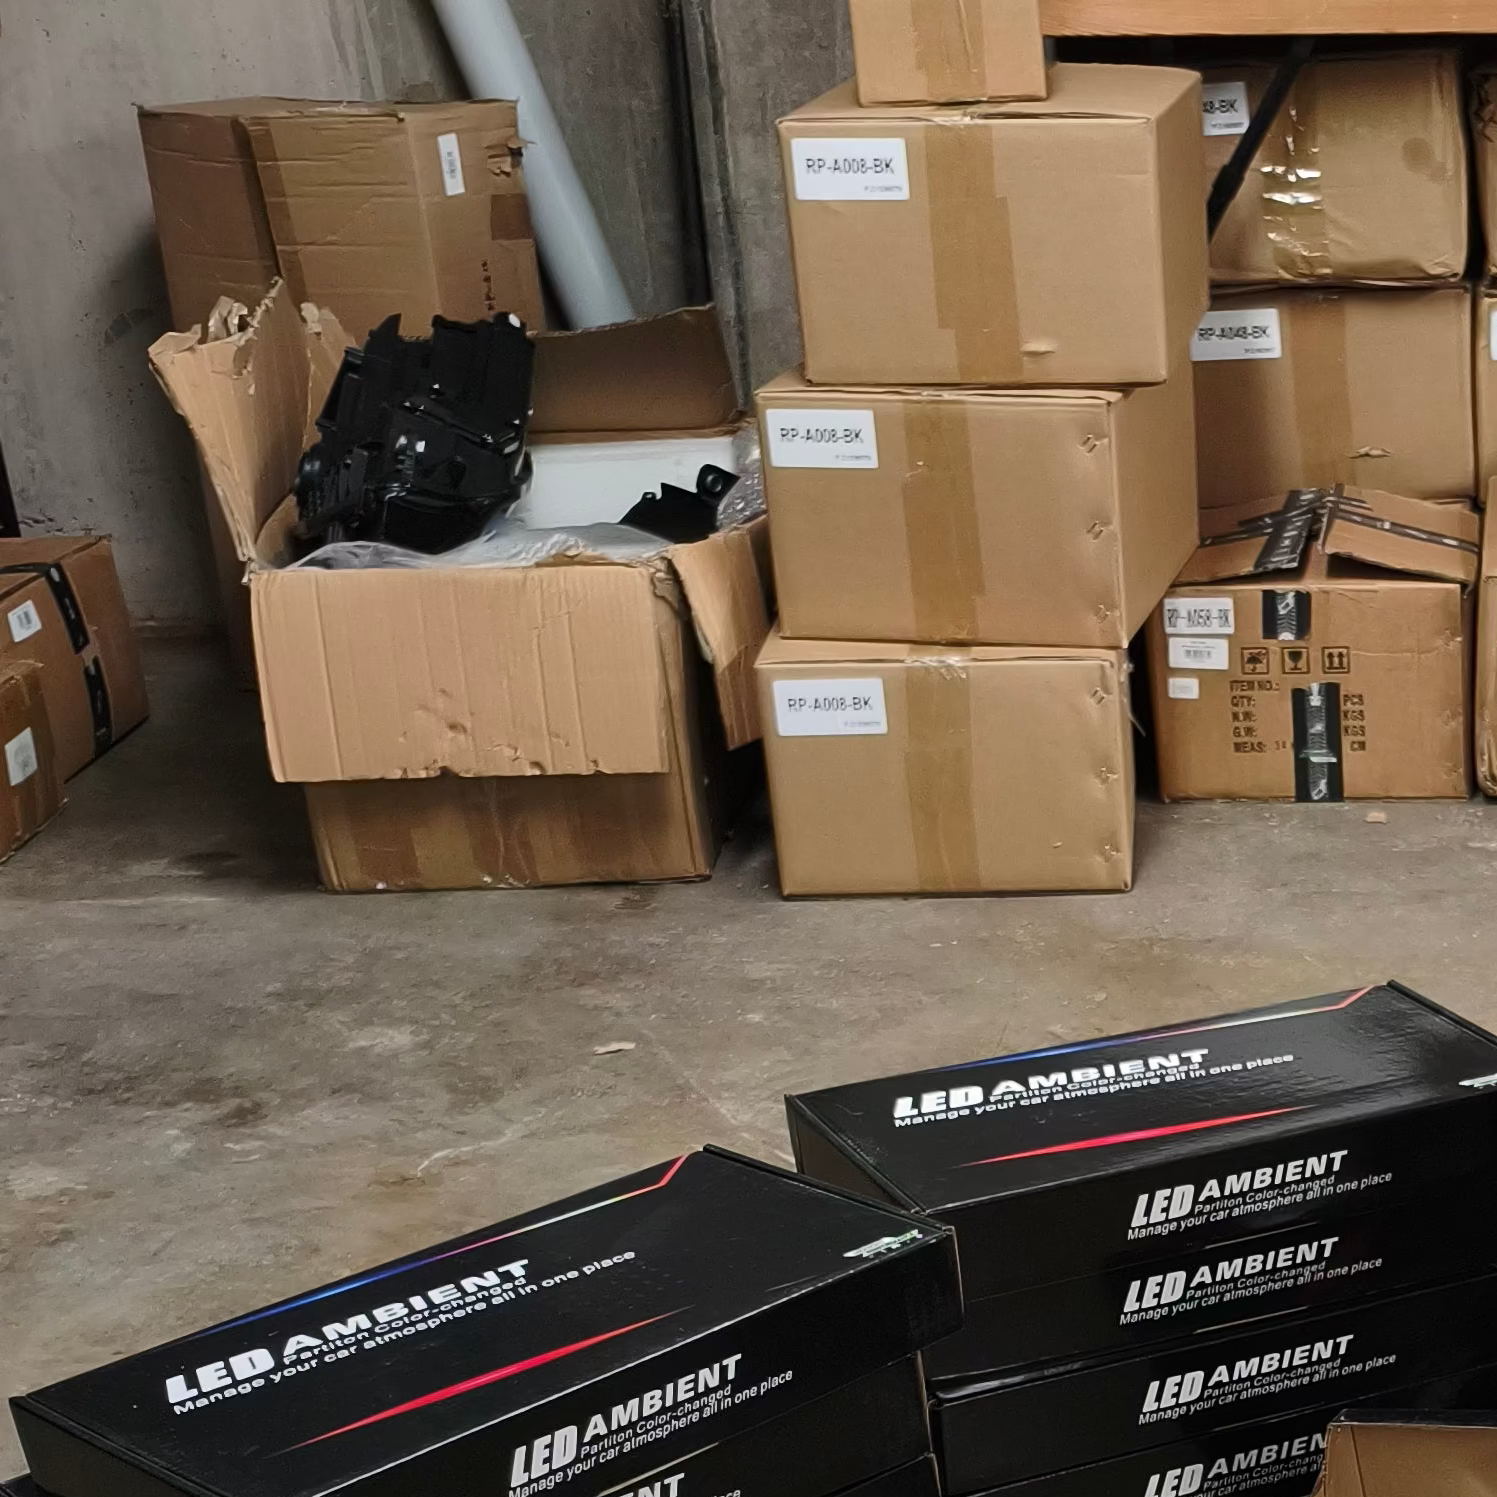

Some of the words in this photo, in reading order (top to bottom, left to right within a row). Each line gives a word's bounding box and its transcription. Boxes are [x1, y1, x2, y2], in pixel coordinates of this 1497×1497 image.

[805, 157, 895, 175] RP-A008-BK
[779, 427, 864, 444] RP-A008-BK
[1230, 680, 1255, 692] ITEM
[1343, 694, 1364, 706] PCS
[787, 695, 873, 712] RP-A008-BK
[1231, 695, 1256, 708] QTY:
[1343, 710, 1365, 722] KGS
[1343, 725, 1366, 737] KGS
[1233, 742, 1267, 753] MEAS:
[1350, 741, 1366, 752] CM
[897, 1086, 984, 1118] LED
[993, 1048, 1209, 1096] AMBIENT
[1131, 1184, 1194, 1228] LED
[1198, 1148, 1348, 1203] AMBIENT
[1245, 1173, 1335, 1203] Color-changed
[1127, 1221, 1176, 1241] Manage
[1180, 1213, 1207, 1232] your
[1209, 1208, 1230, 1223] car
[1232, 1193, 1303, 1217] atmosphere
[1306, 1185, 1320, 1199] all
[1322, 1185, 1333, 1197] in
[1336, 1181, 1358, 1193] one
[1360, 1172, 1392, 1191] place
[1123, 1270, 1186, 1313] LED
[1190, 1235, 1339, 1289] AMBIENT
[376, 1277, 532, 1332] Color-changed
[164, 1349, 277, 1404] LED
[287, 1258, 530, 1356] AMBIENT
[171, 1377, 265, 1414] Manage
[268, 1358, 317, 1382] your
[323, 1344, 359, 1361] car
[361, 1302, 488, 1348] atmosphere
[491, 1289, 517, 1304] all
[518, 1284, 541, 1295] in
[543, 1270, 581, 1285] one
[580, 1251, 637, 1274] place
[1142, 1370, 1204, 1413] LED
[1207, 1333, 1354, 1388] AMBIENT
[1253, 1357, 1341, 1386] Color-changed
[511, 1425, 577, 1488] LED
[583, 1352, 742, 1445] AMBIENT
[1207, 1432, 1326, 1478] AMBIEN
